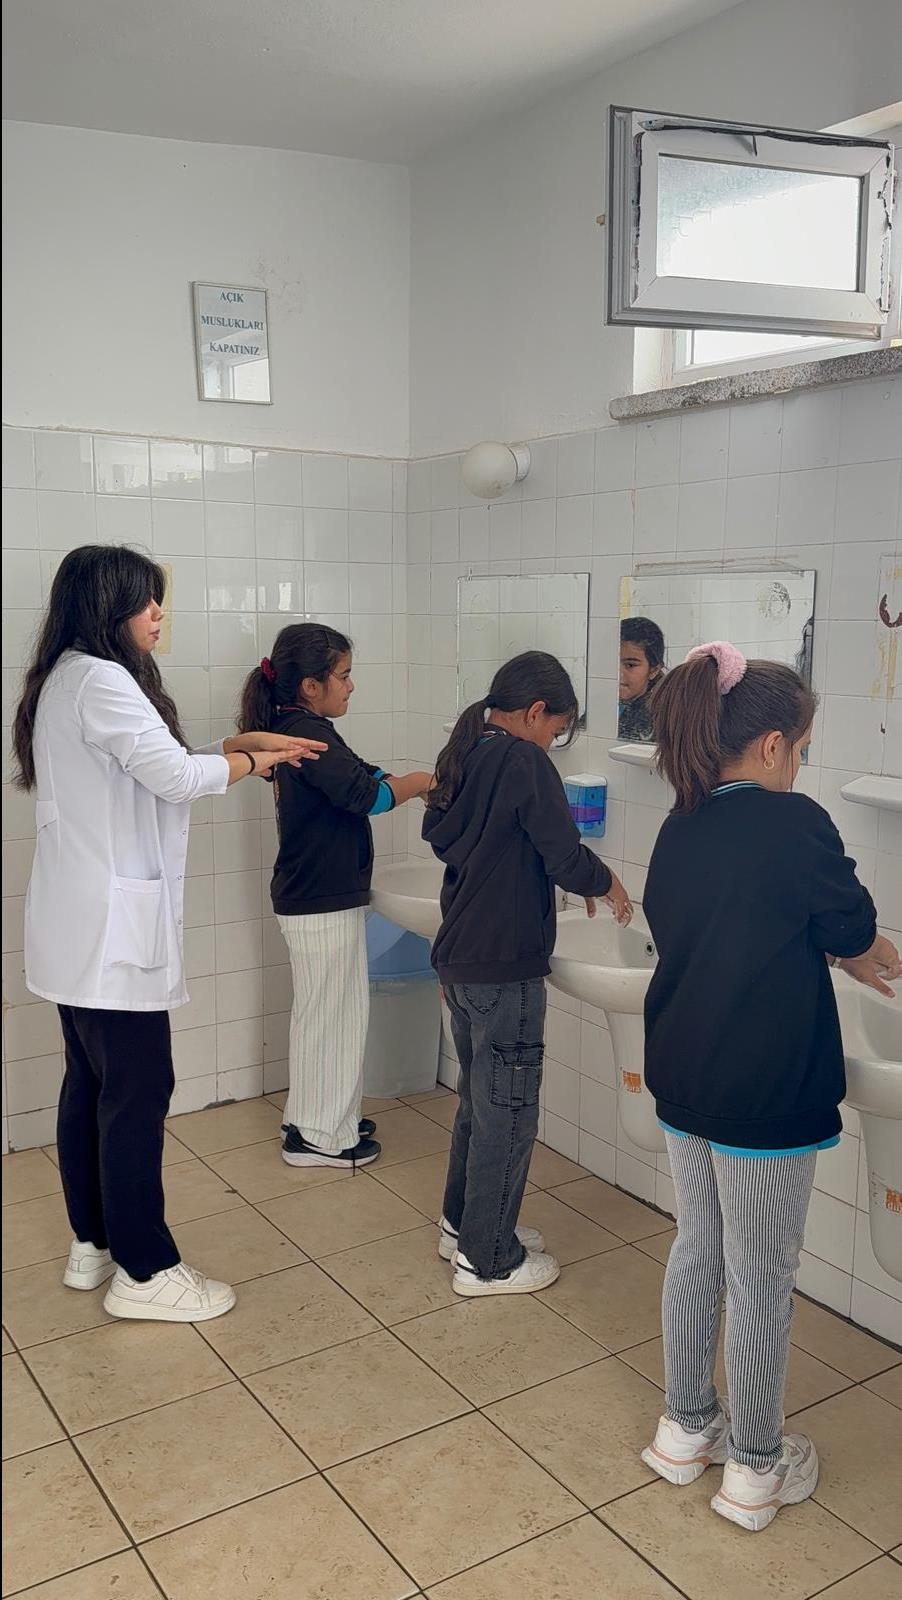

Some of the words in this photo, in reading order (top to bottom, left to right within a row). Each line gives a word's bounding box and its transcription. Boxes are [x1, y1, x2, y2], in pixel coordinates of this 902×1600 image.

[220, 292, 244, 303] AÇIK
[201, 315, 264, 330] MUSLUKLARI
[209, 342, 260, 355] KAPATINIZ
